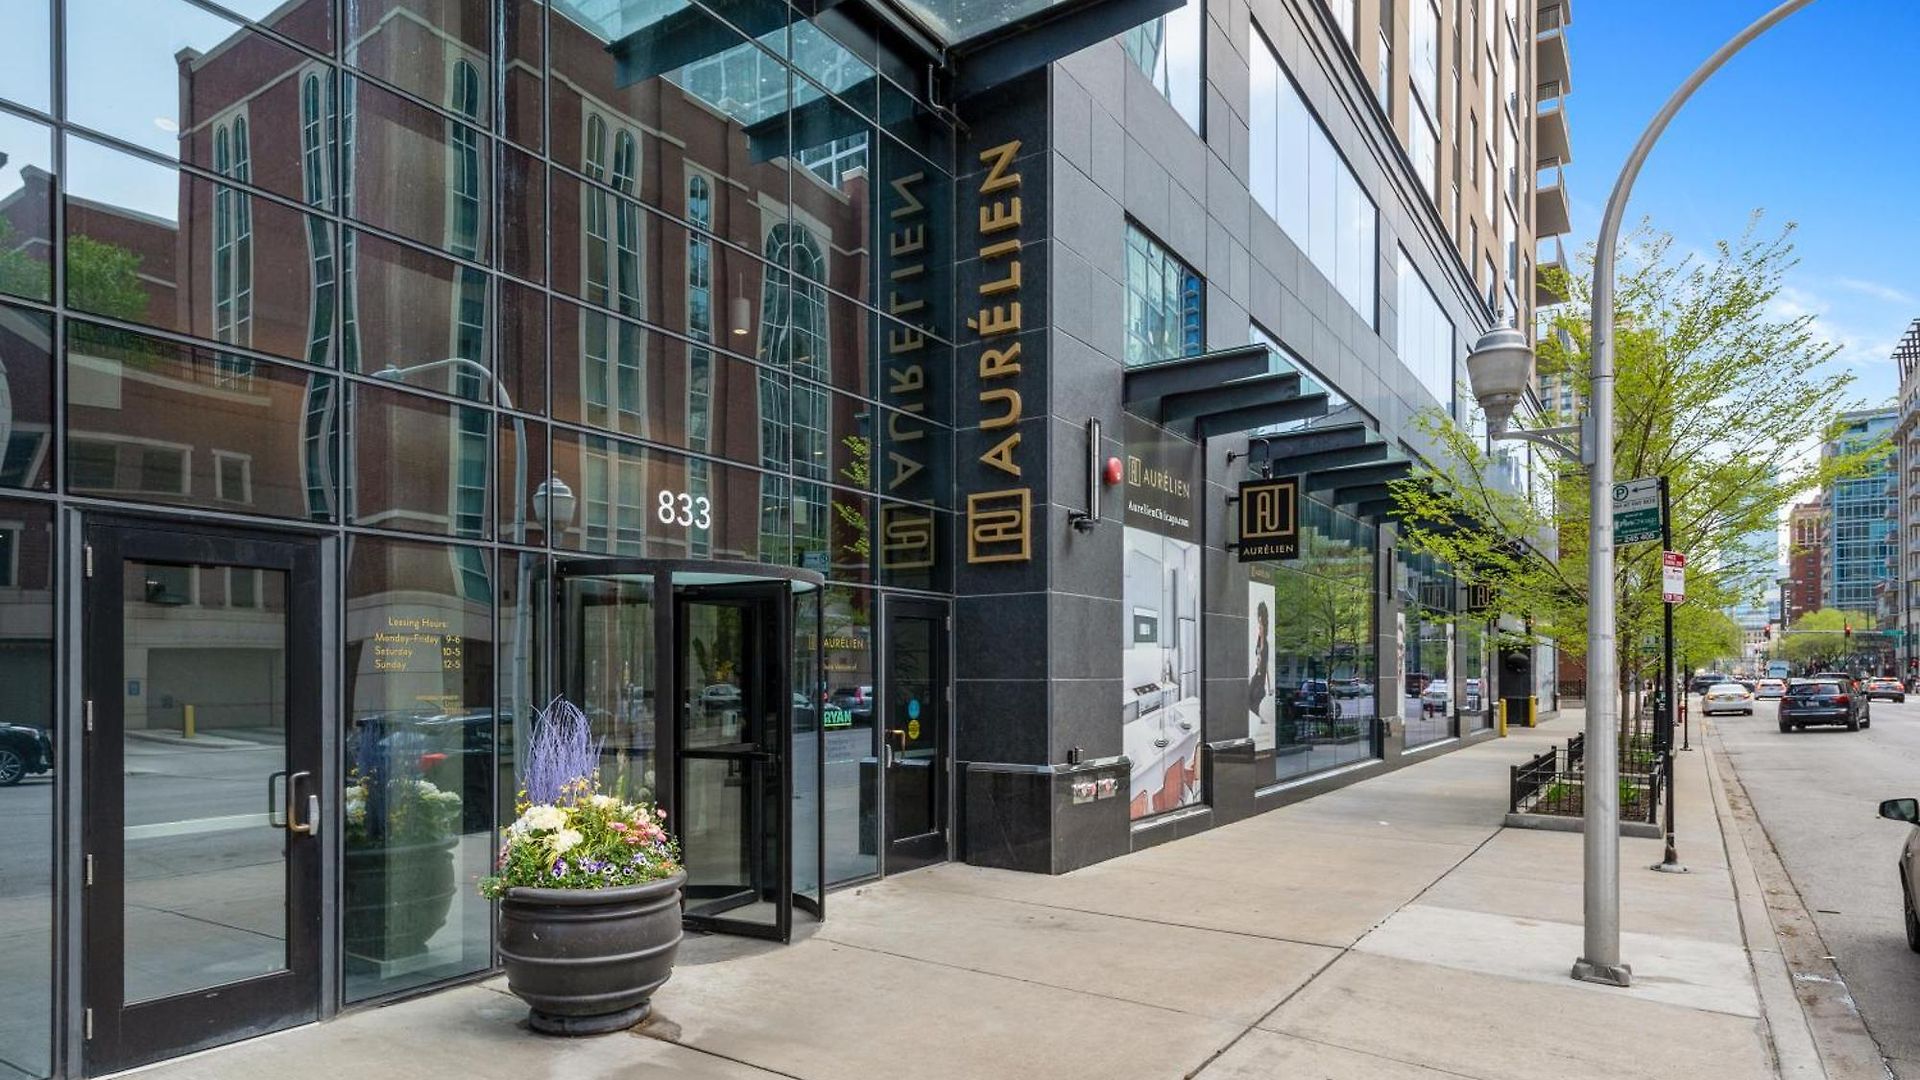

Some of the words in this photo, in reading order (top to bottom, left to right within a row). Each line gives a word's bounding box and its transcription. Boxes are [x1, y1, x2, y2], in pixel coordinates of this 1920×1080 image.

[967, 139, 1022, 476] AURÉLIEN
[1143, 467, 1190, 499] AURÉLIEN
[657, 490, 711, 530] 833
[1243, 543, 1294, 556] AURÉLIEN
[421, 617, 448, 629] Hours
[374, 645, 413, 658] Saturday
[374, 659, 407, 671] Sunday
[823, 711, 852, 724] RYAN
